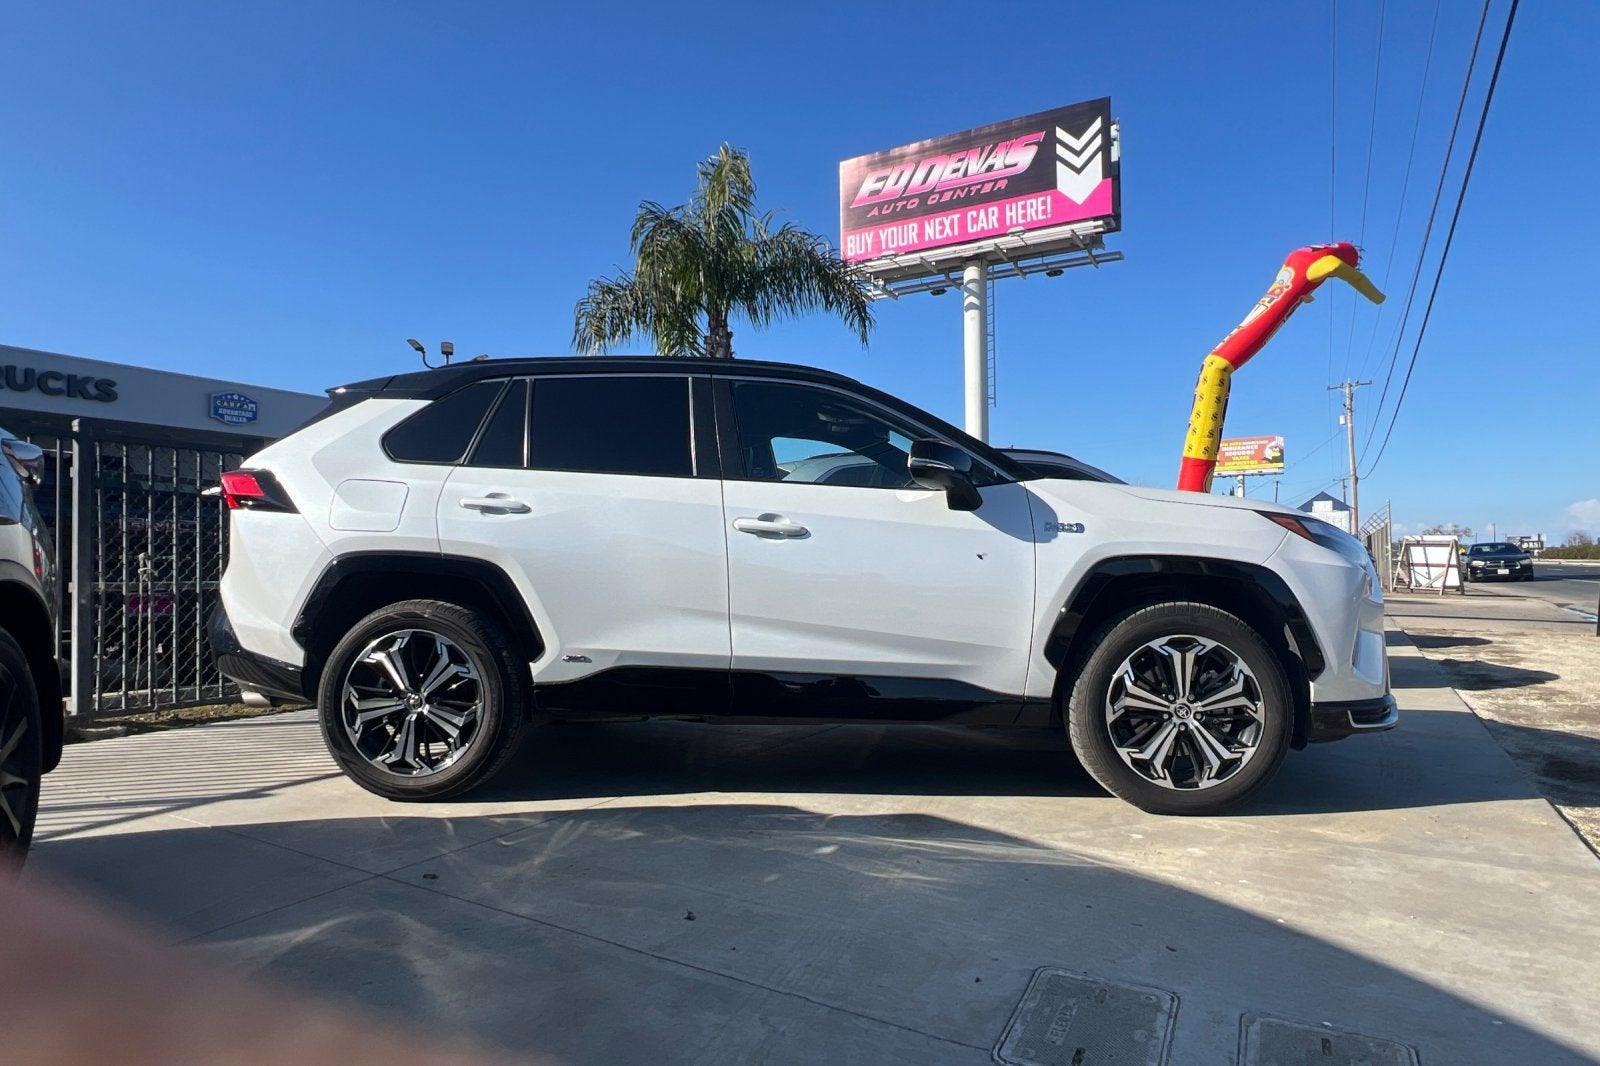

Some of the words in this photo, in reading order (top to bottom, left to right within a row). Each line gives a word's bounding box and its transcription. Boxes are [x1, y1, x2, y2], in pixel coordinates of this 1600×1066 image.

[867, 197, 920, 218] AUTO
[927, 179, 1009, 205] CENTER
[847, 231, 874, 256] BUY
[878, 222, 918, 249] YOUR
[924, 213, 960, 242] NEXT
[967, 206, 999, 233] CAR
[1005, 195, 1052, 226] HERE!
[0, 365, 118, 403] UCKS
